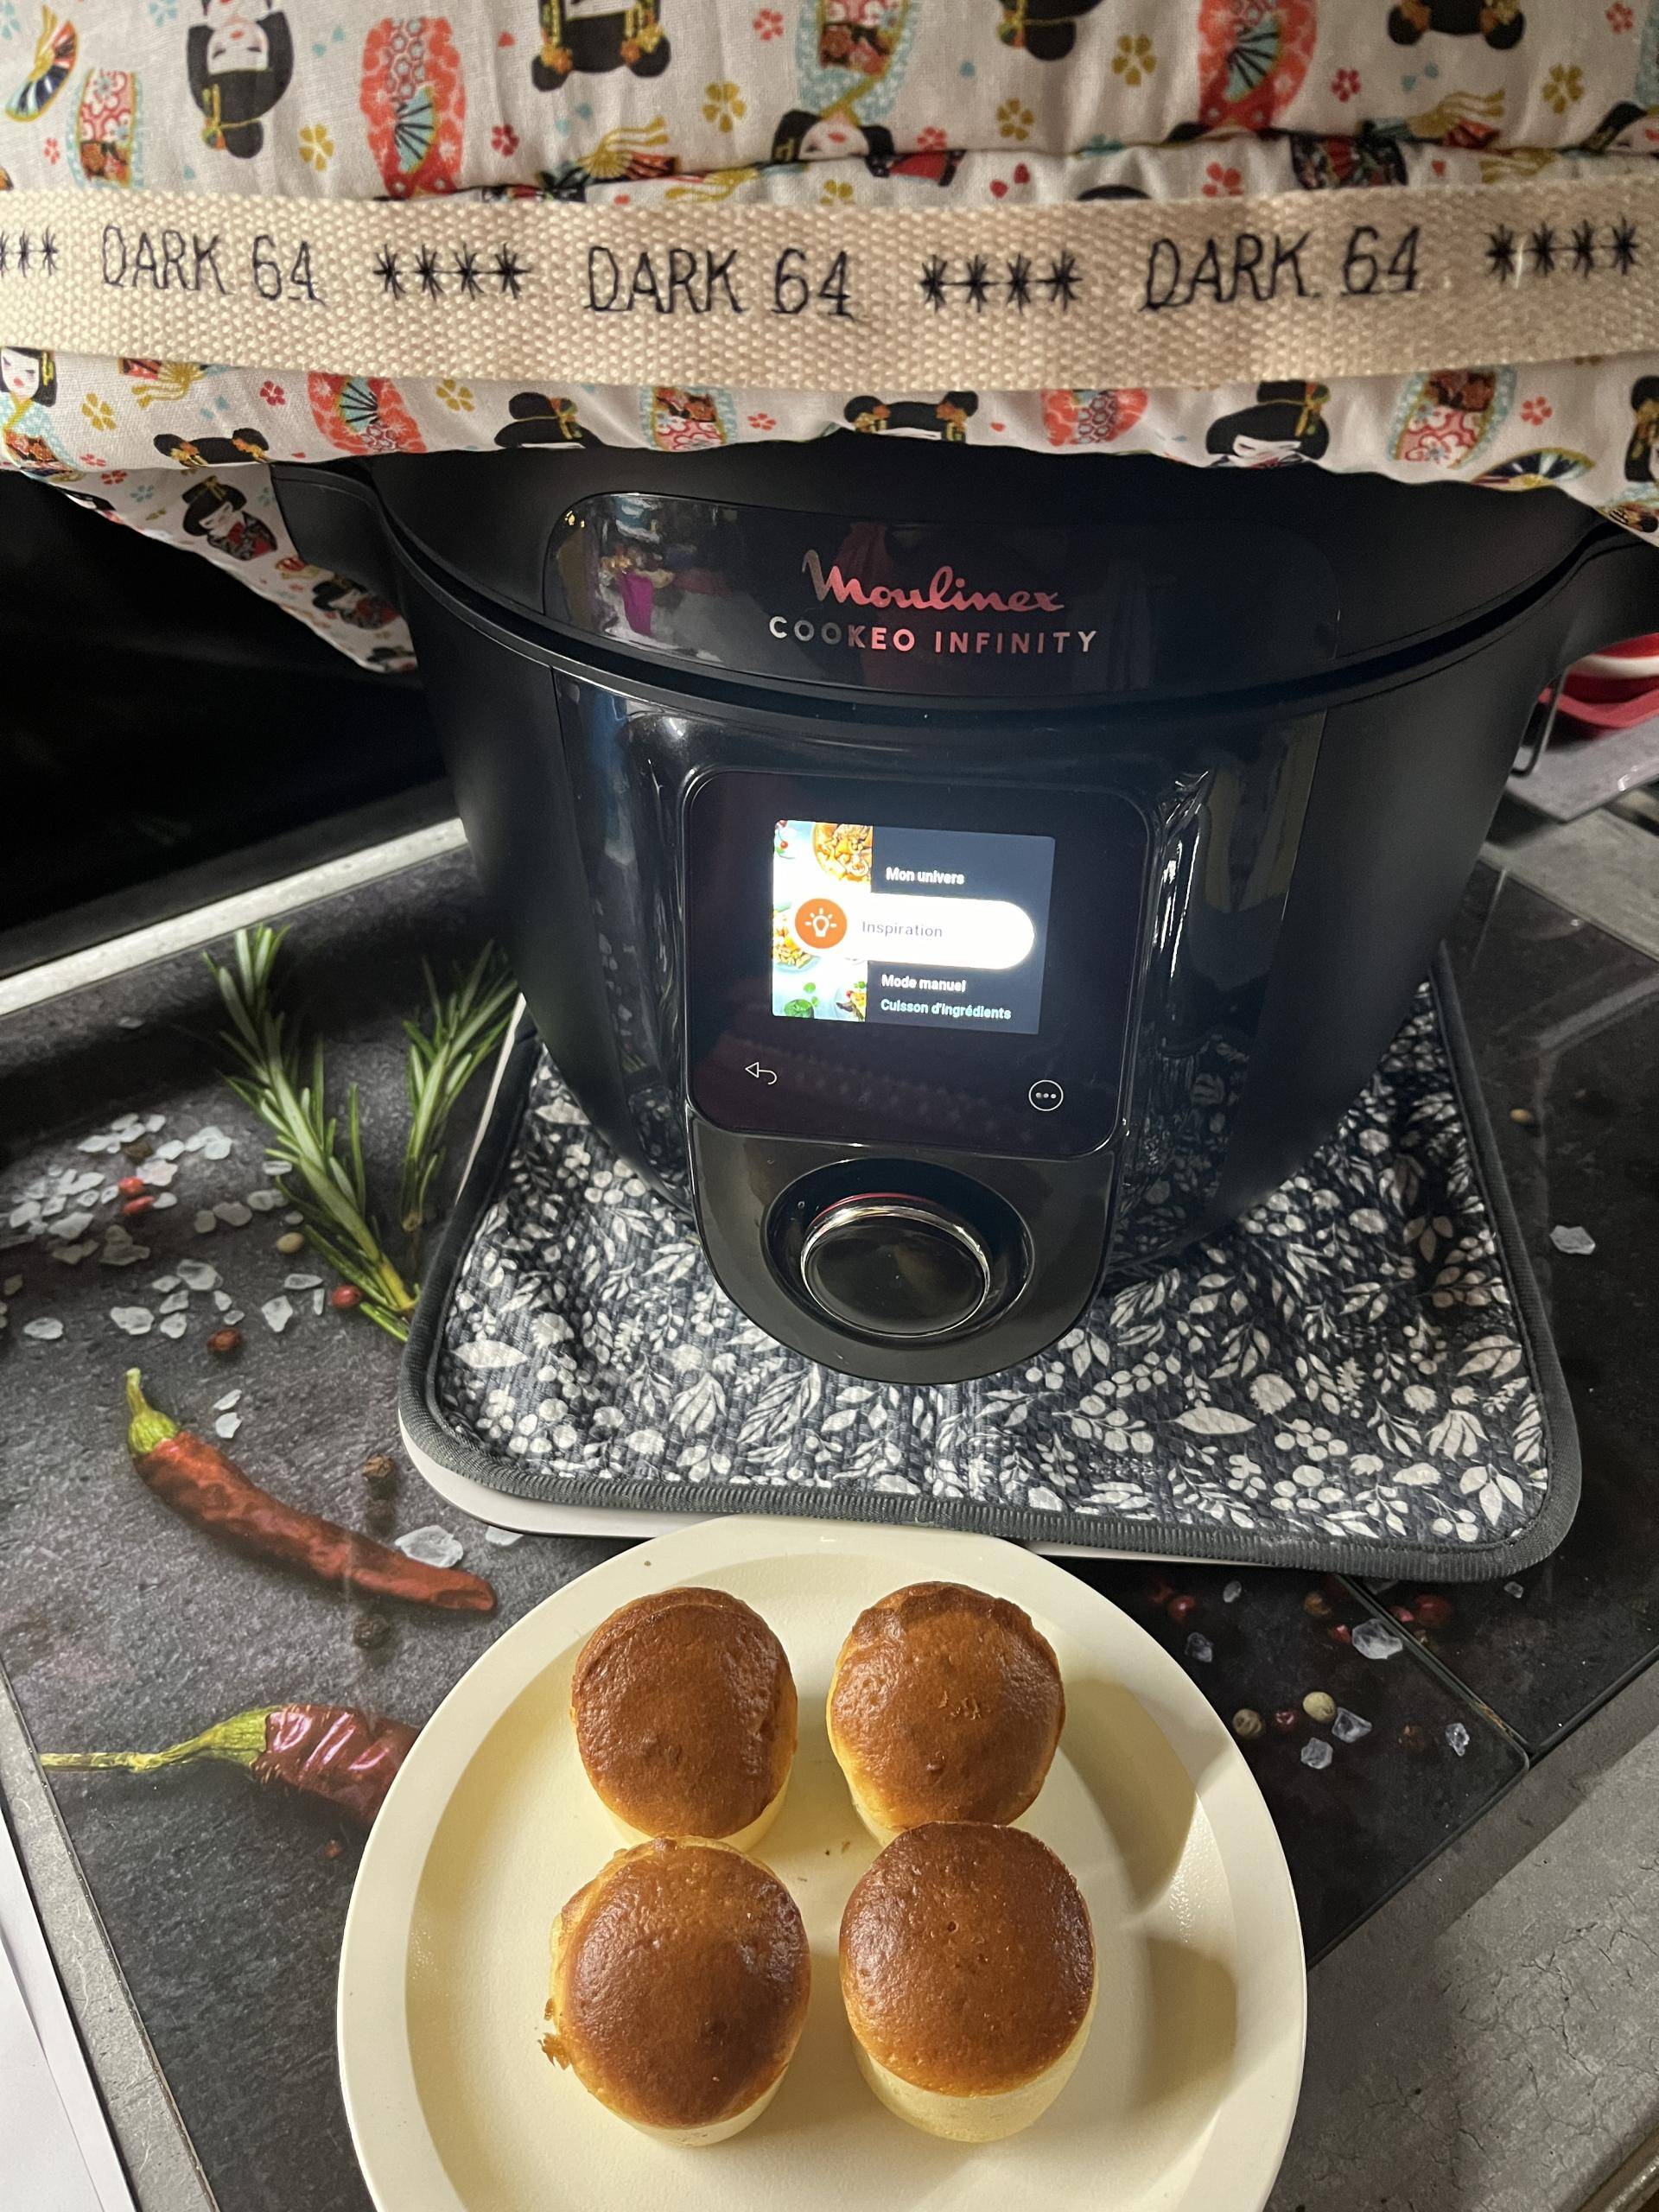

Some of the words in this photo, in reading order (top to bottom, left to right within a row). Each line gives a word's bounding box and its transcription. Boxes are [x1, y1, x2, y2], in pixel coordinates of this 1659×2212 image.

[102, 224, 232, 296] DARK
[252, 234, 327, 306] 64
[583, 245, 744, 314] DARK
[771, 247, 866, 321] 64
[1140, 230, 1322, 312] DARK
[1342, 226, 1421, 296] 64
[802, 550, 1065, 612] Moulinex
[769, 616, 916, 652] COOKEO
[935, 631, 1096, 654] INFINITY
[886, 867, 915, 882] Mon
[918, 870, 965, 886] univers
[861, 921, 943, 938] Inspiration
[881, 974, 918, 988] Mode
[919, 977, 967, 993] manuel
[880, 999, 929, 1014] Cuisson
[931, 1002, 1012, 1020] d'ingrédients
